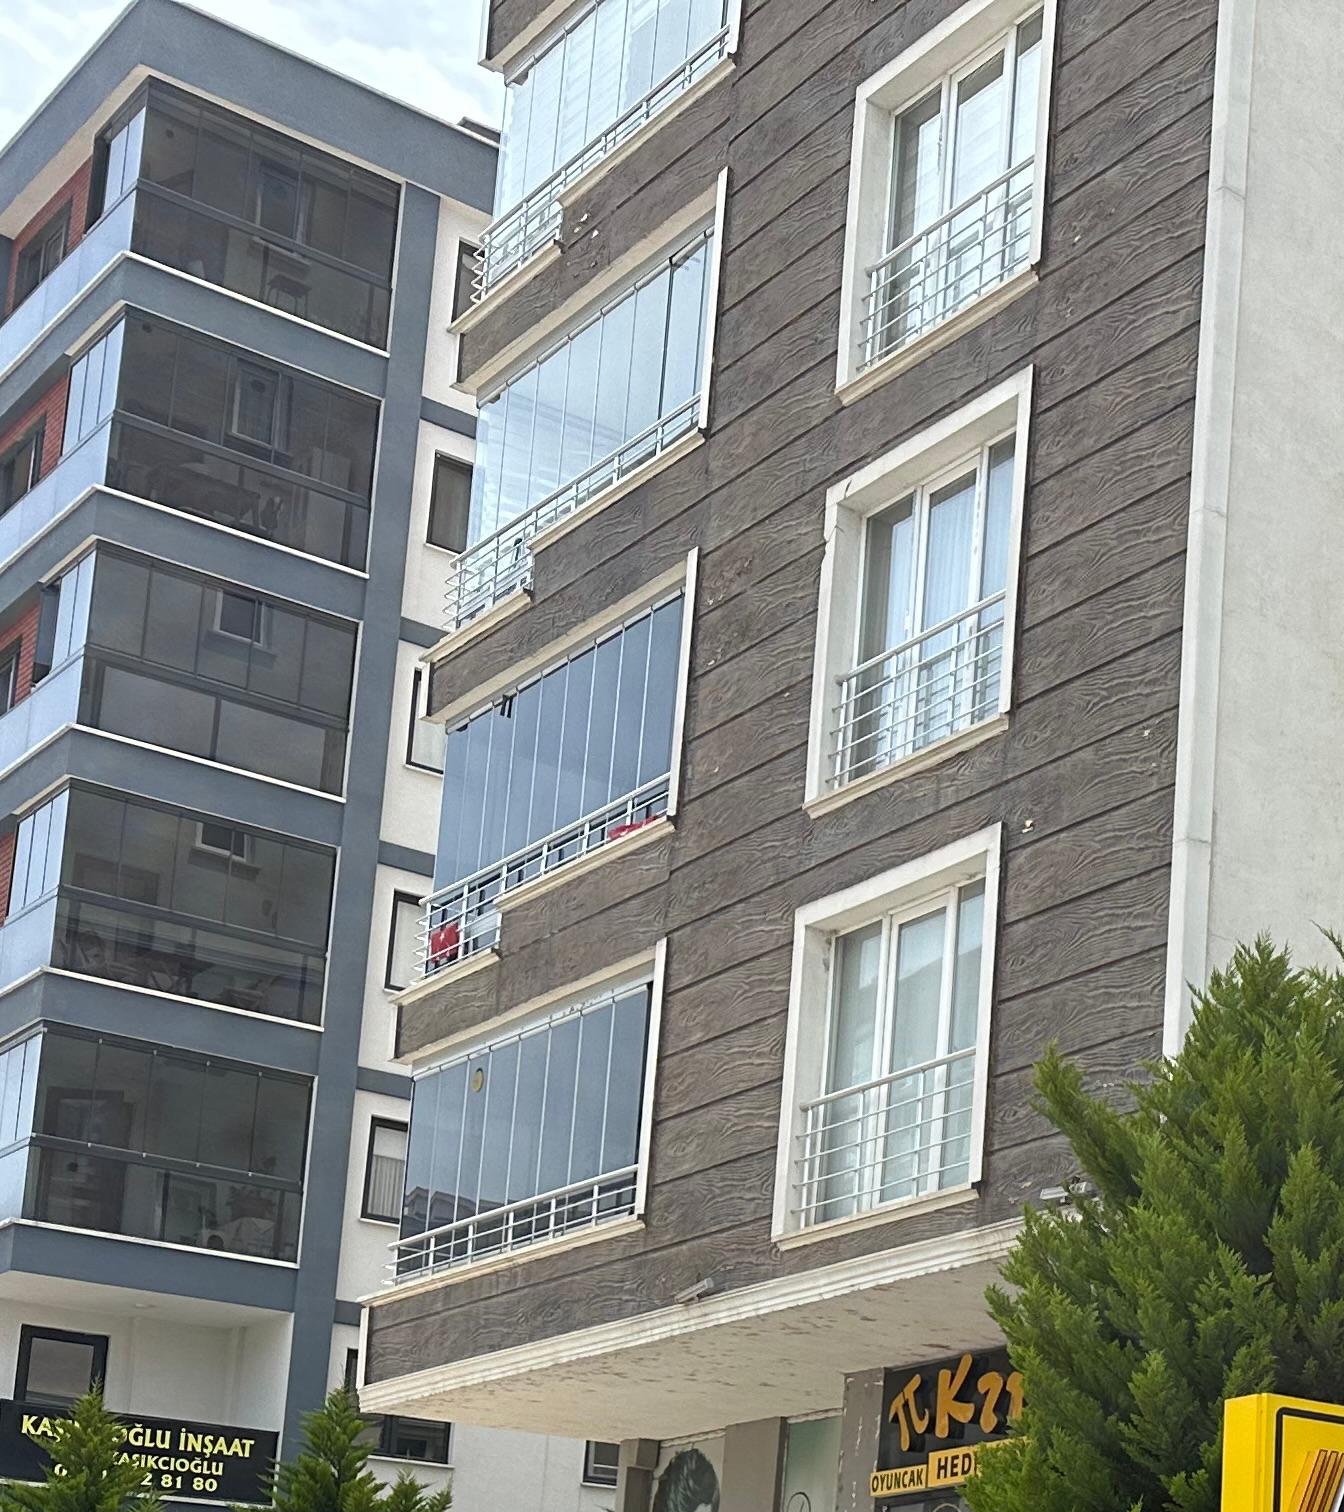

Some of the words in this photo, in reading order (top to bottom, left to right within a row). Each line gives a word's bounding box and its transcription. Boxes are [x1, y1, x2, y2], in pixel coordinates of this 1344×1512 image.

[179, 1427, 255, 1459] İNŞAAT
[160, 1474, 183, 1490] 81
[192, 1476, 218, 1493] 80
[871, 1468, 924, 1493] OYUNCAK
[936, 1452, 977, 1480] HED
